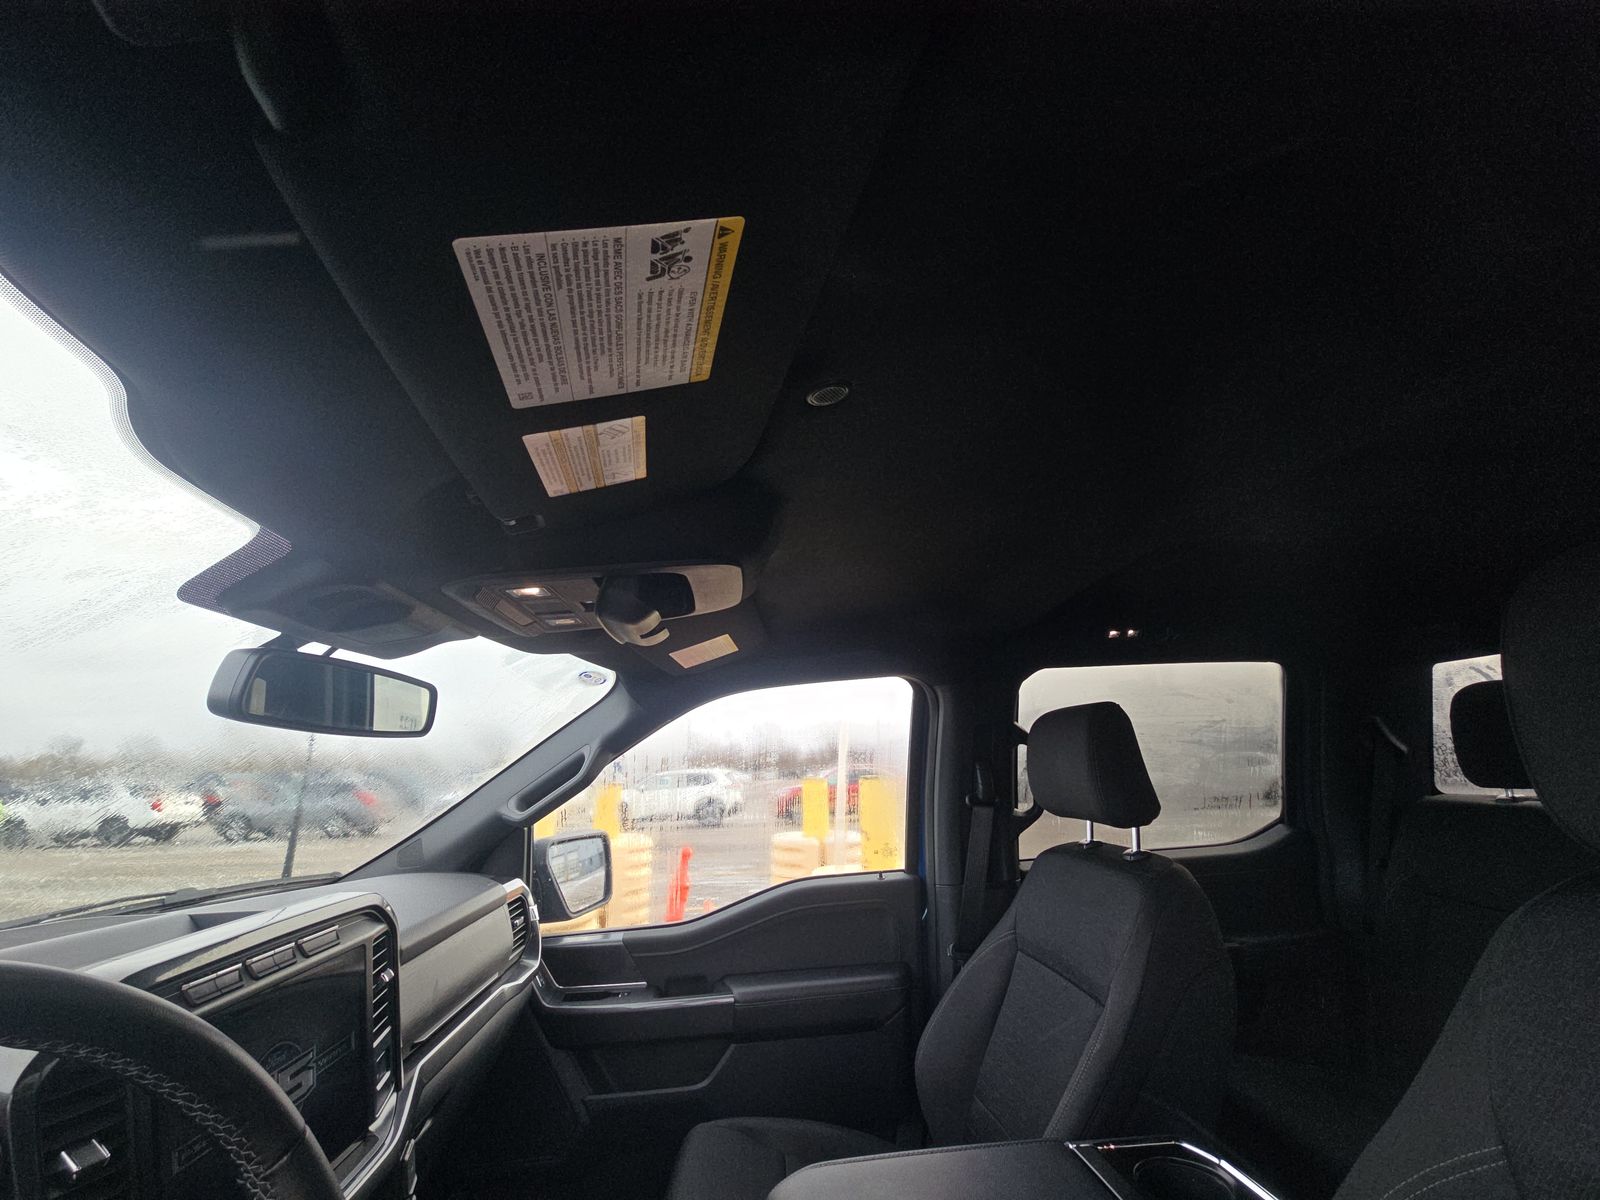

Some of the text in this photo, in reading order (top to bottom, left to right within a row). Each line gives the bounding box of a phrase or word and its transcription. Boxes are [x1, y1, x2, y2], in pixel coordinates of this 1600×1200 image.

[612, 237, 623, 259] MÊME
[613, 260, 623, 280] AVEC
[712, 241, 728, 279] WARNING
[535, 252, 551, 292] INCLUSIVE
[614, 281, 623, 295] DES
[543, 292, 554, 307] CON
[614, 296, 623, 313] SACS
[546, 308, 556, 321] LAS
[548, 322, 560, 345] NUEVAS
